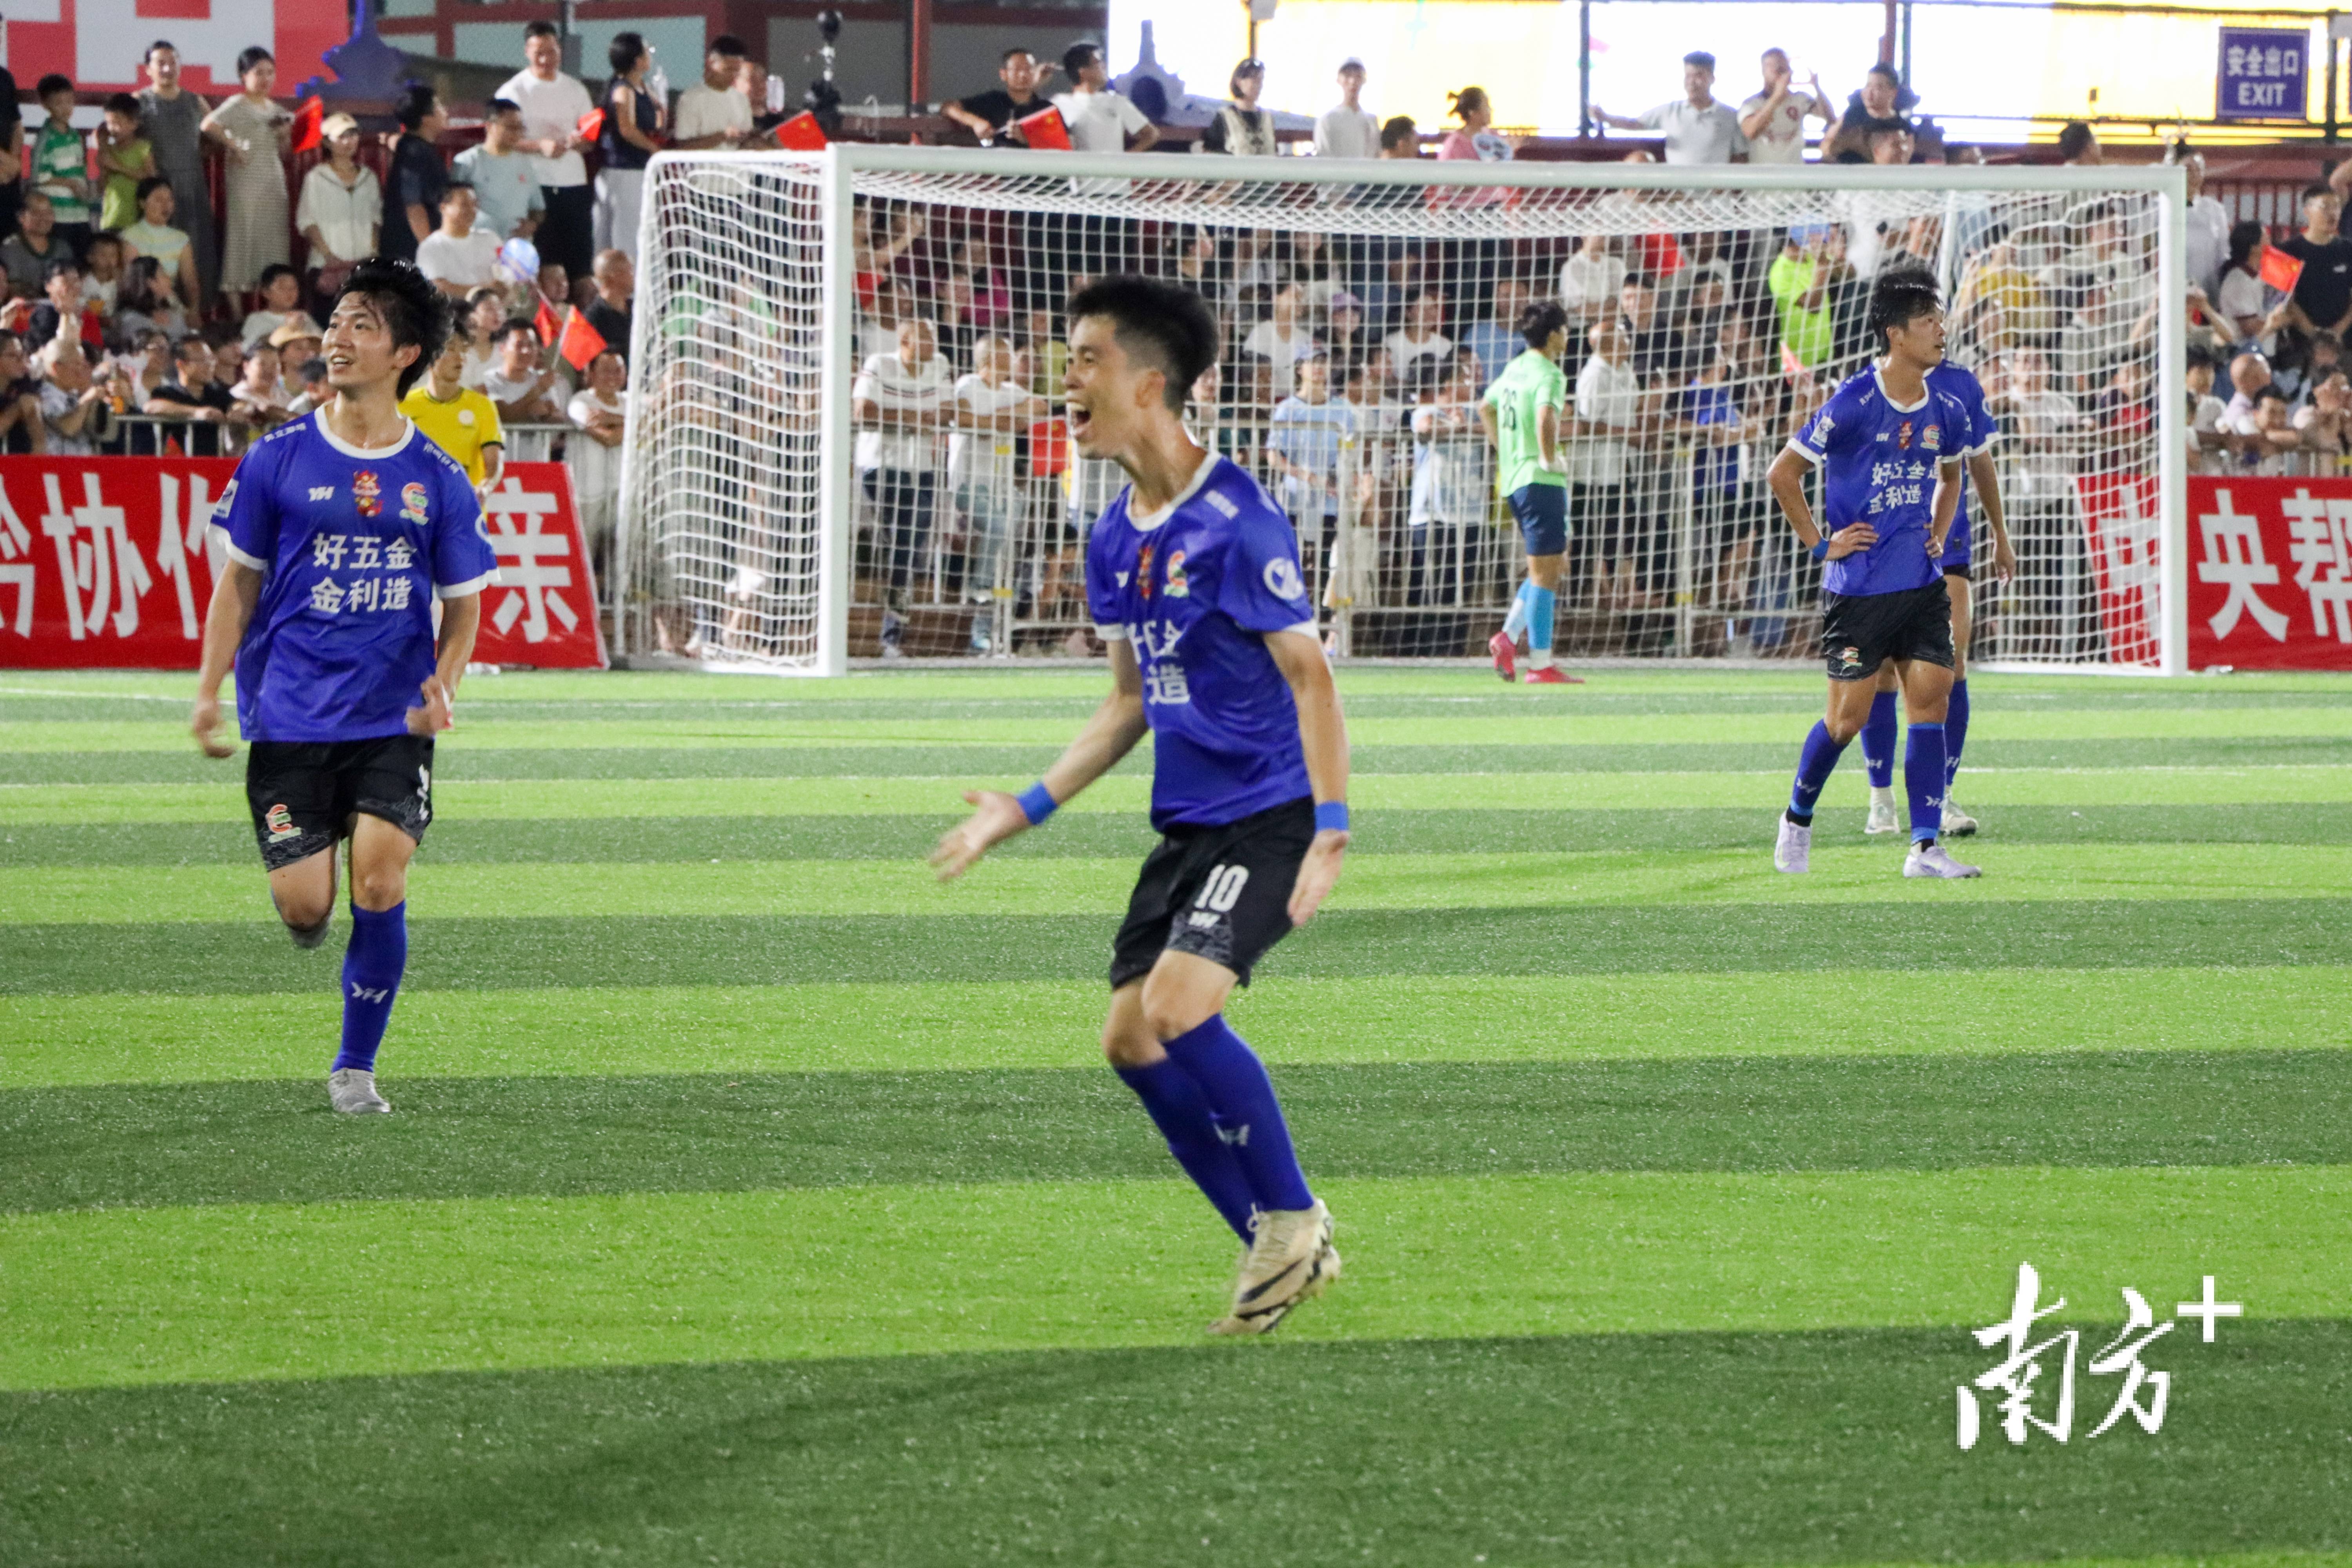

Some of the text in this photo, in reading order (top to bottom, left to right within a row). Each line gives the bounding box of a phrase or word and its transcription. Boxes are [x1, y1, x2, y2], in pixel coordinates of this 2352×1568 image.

[2227, 45, 2299, 77] 安全出口
[2238, 82, 2287, 106] EXIT
[312, 532, 417, 571] 好五金
[309, 575, 413, 614] 金利造
[1195, 864, 1250, 912] 10
